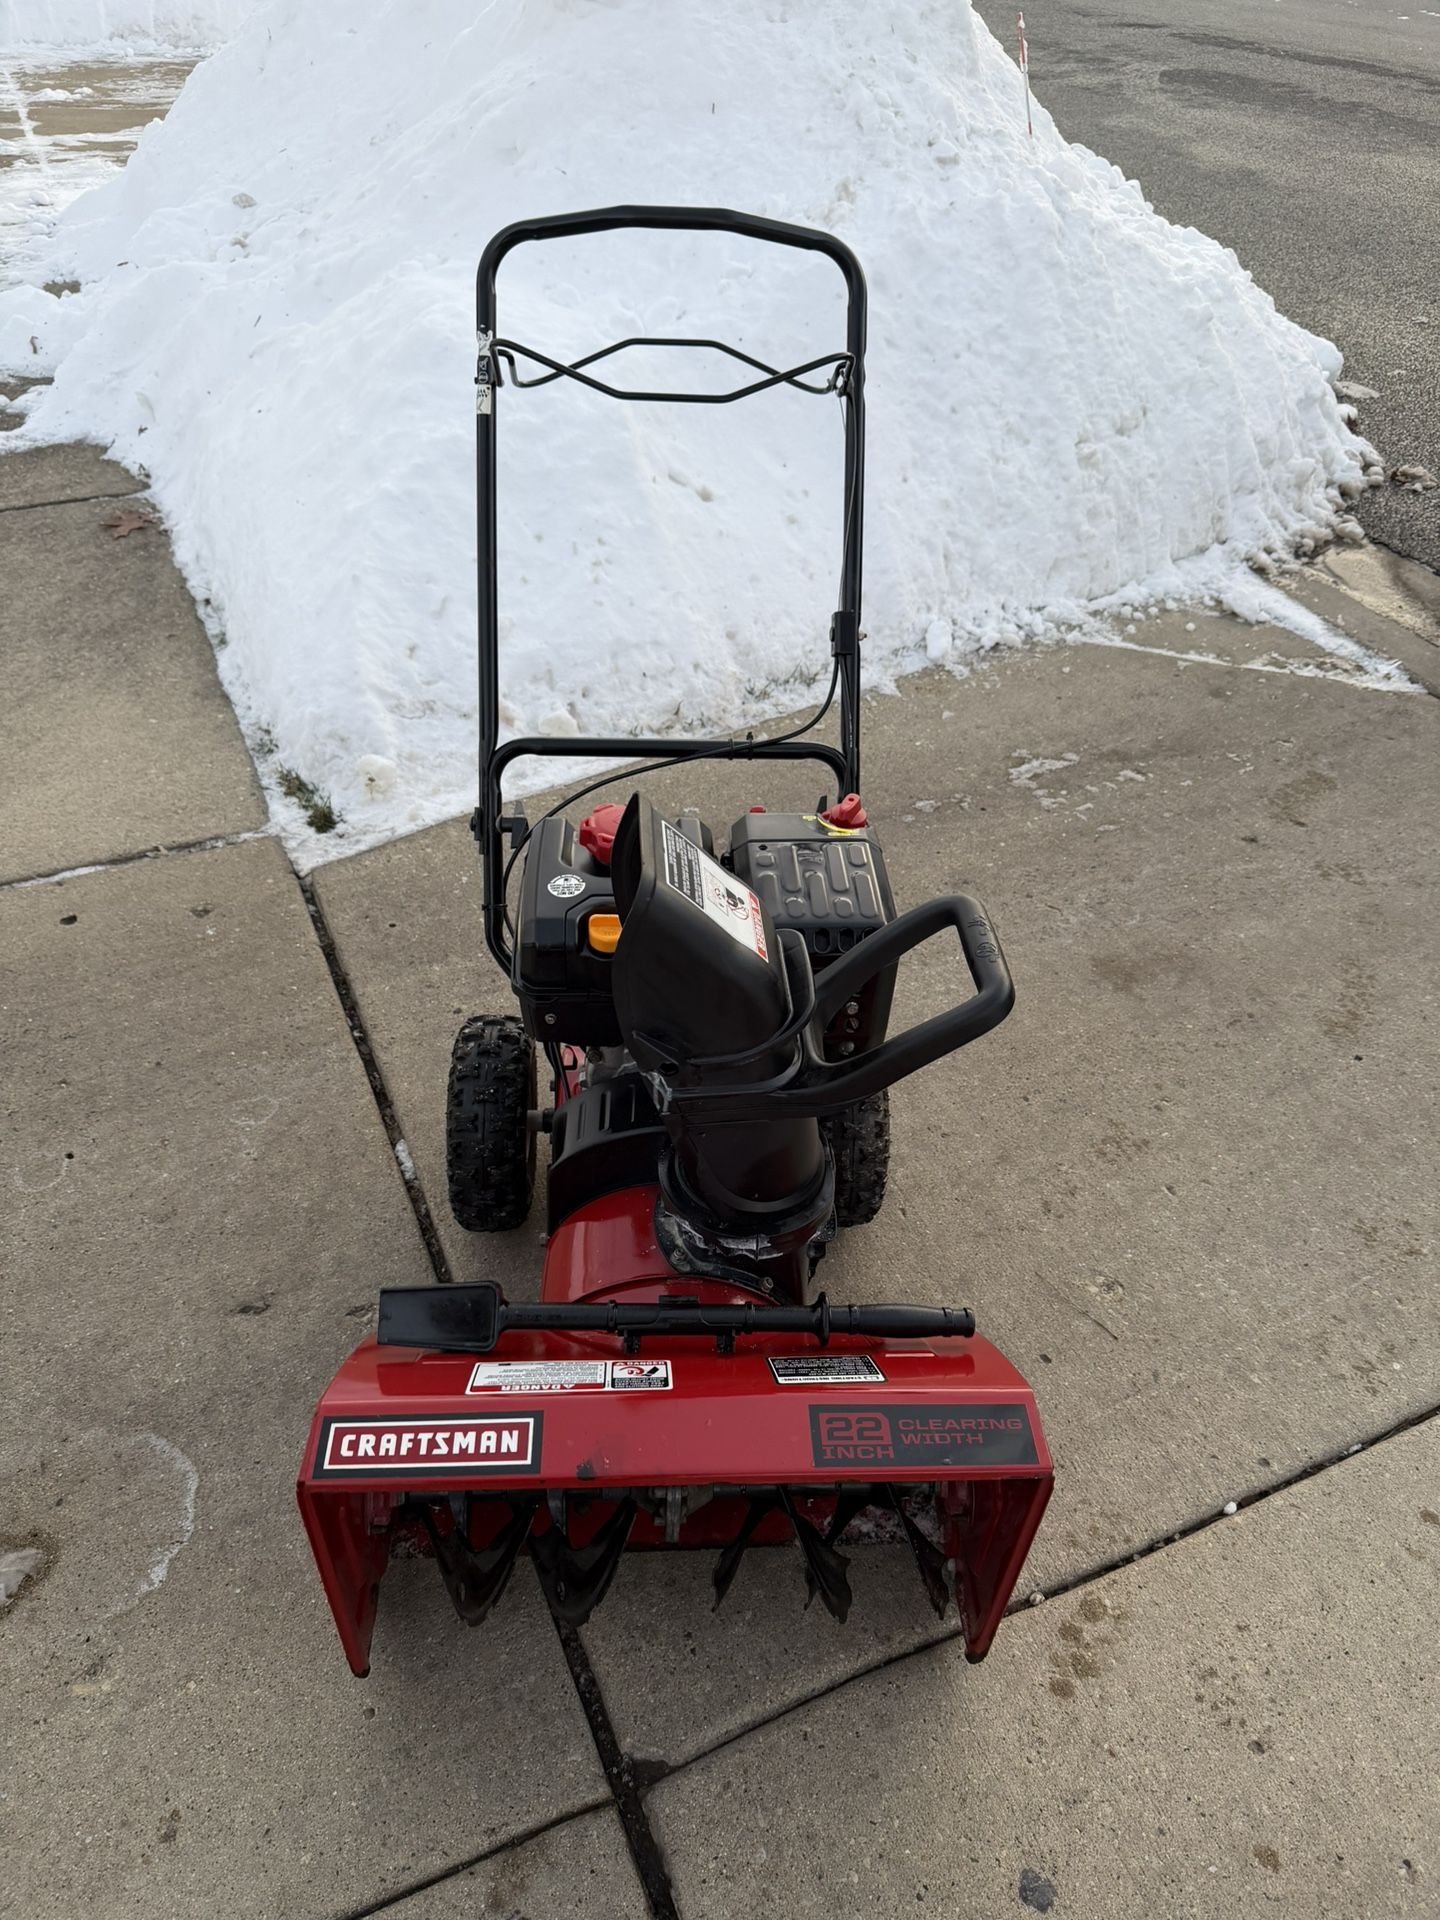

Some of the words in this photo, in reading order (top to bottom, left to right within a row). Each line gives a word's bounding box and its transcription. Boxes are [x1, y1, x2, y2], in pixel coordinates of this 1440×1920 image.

[826, 1416, 884, 1441] 22
[897, 1418, 1024, 1431] CLEARING
[340, 1429, 520, 1457] CRAFTSMAN
[900, 1433, 984, 1446] WIDTH
[822, 1446, 895, 1460] INCH
